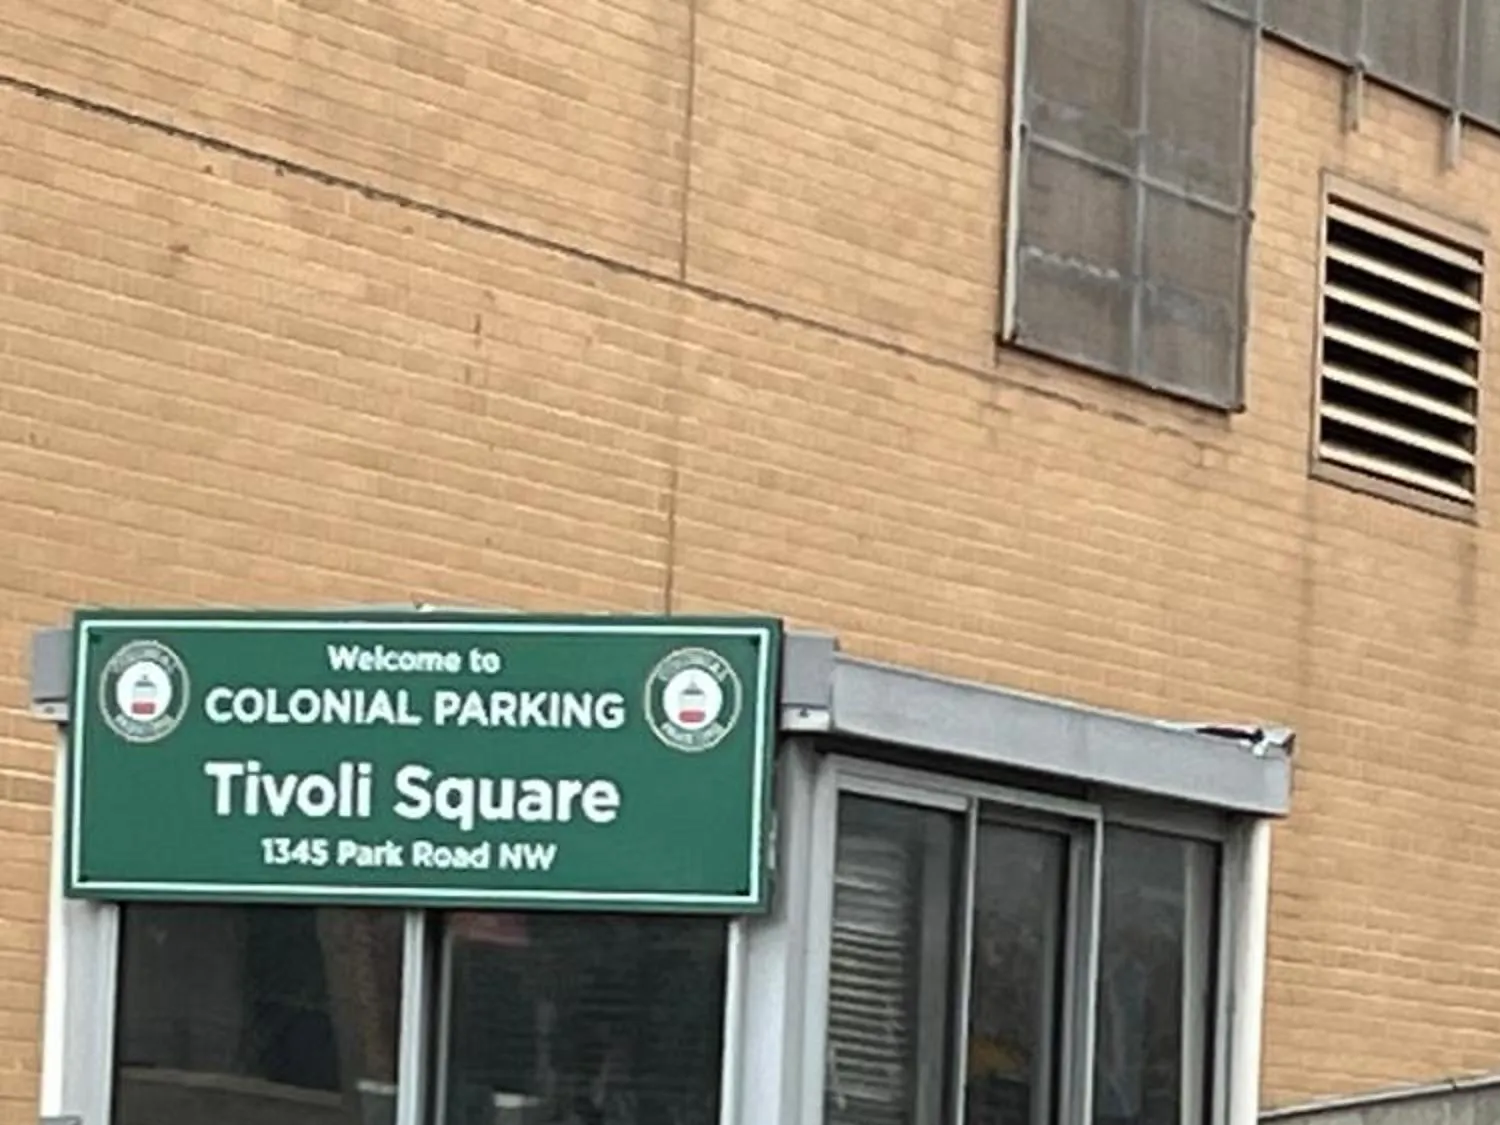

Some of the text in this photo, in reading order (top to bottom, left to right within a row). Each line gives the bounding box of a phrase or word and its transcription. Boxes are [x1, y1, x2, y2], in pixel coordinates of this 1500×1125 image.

[327, 644, 501, 673] Welcome to
[204, 687, 422, 726] COLONIAL
[434, 690, 626, 729] PARKING
[204, 760, 621, 831] Tivoli Square
[261, 837, 558, 871] 1345 Park Road NW
